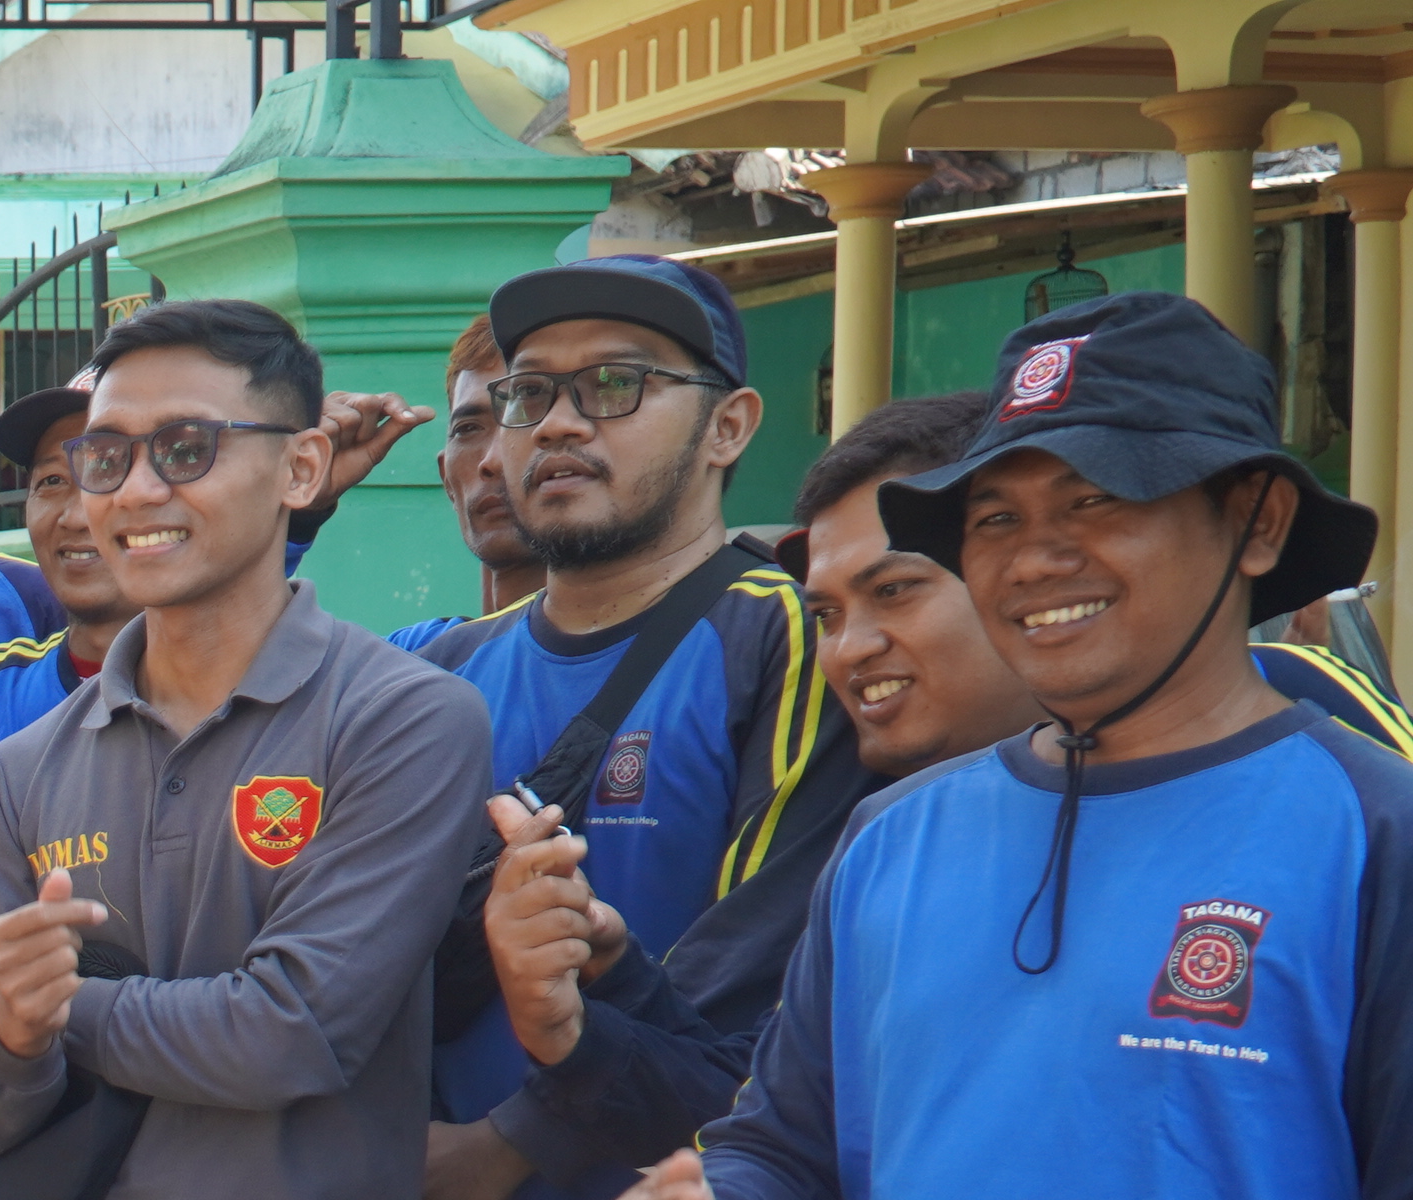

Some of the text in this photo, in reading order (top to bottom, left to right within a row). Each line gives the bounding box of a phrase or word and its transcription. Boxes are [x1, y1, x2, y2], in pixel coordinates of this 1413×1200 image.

[605, 816, 617, 825] the
[618, 816, 634, 825] First
[1183, 901, 1263, 926] TAGANA
[1120, 1034, 1269, 1063] We are the First to Help
